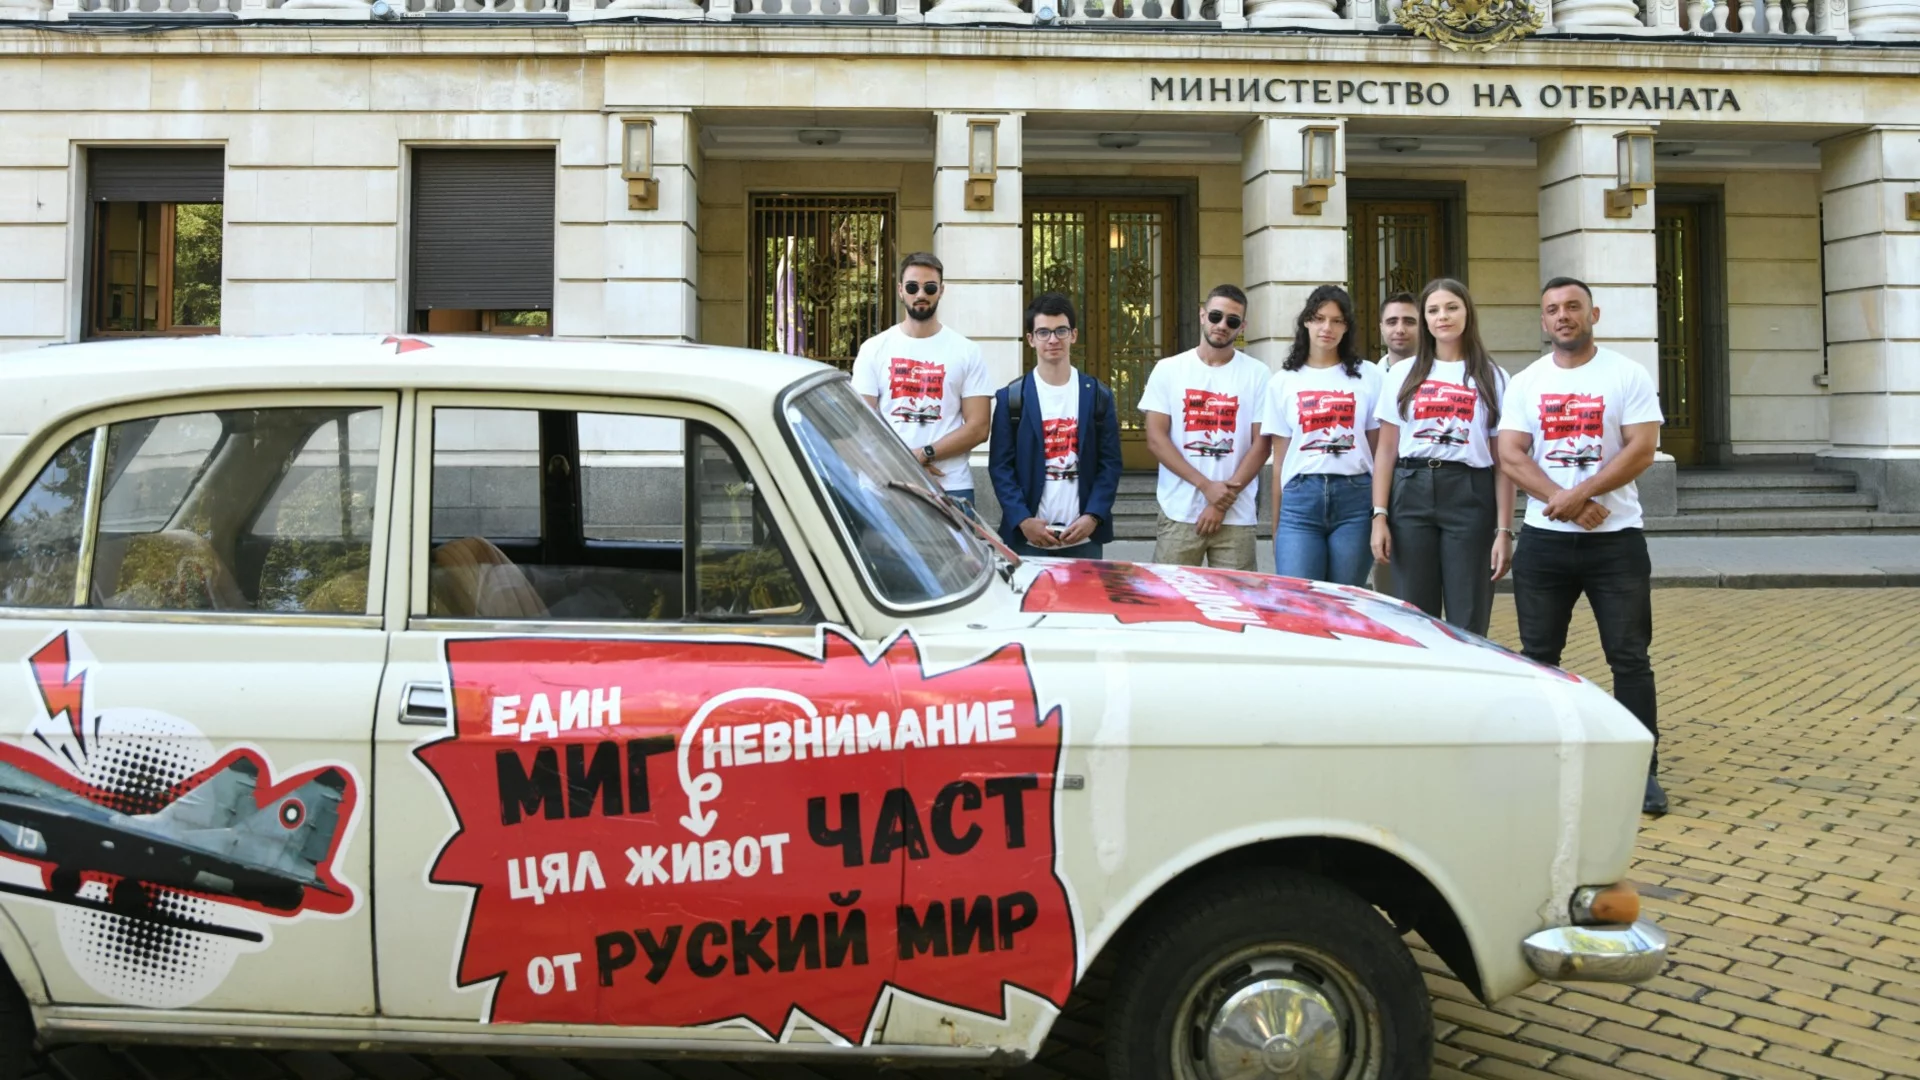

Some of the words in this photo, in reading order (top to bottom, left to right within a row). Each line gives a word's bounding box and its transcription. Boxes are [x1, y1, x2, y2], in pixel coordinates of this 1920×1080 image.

[1150, 76, 1450, 106] МИНИСТЕРСТВО
[1473, 83, 1522, 108] НА
[1539, 84, 1741, 111] ОТБРАНАТА
[491, 686, 622, 741] ЕДИН
[495, 736, 675, 827] МИГ
[702, 700, 1016, 769] НЕВНИМАНИЕ
[507, 850, 606, 905] ЦЯЛ
[625, 833, 790, 887] ЖИВОТ
[807, 775, 1039, 868] ЧАСТ
[527, 953, 581, 995] ОТ
[595, 890, 870, 986] РУСКИЙ
[895, 891, 1039, 961] МИР
